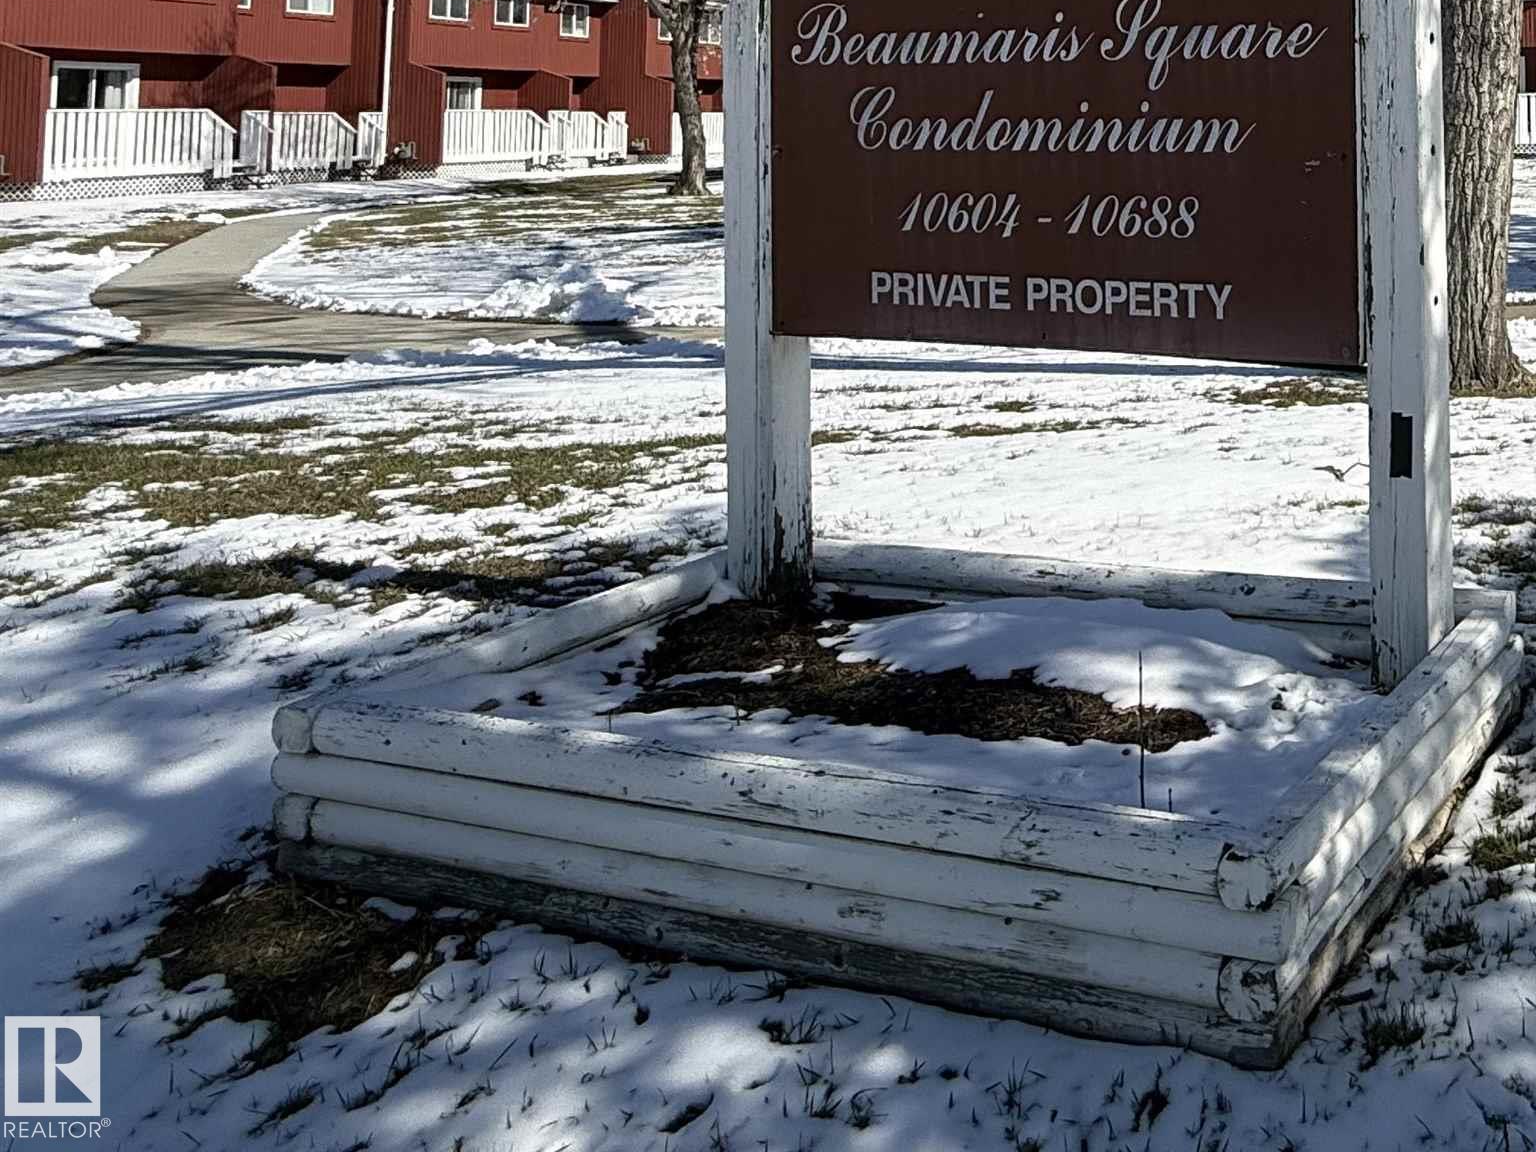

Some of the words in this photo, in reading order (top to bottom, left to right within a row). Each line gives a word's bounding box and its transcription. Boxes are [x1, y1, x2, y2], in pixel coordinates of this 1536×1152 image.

[791, 2, 1094, 66] Beaumaris
[849, 86, 1257, 154] Condominium
[899, 192, 1021, 238] 10604
[1064, 194, 1200, 239] 10688
[871, 272, 1011, 310] PRIVATE
[1026, 276, 1233, 320] PROPERTY
